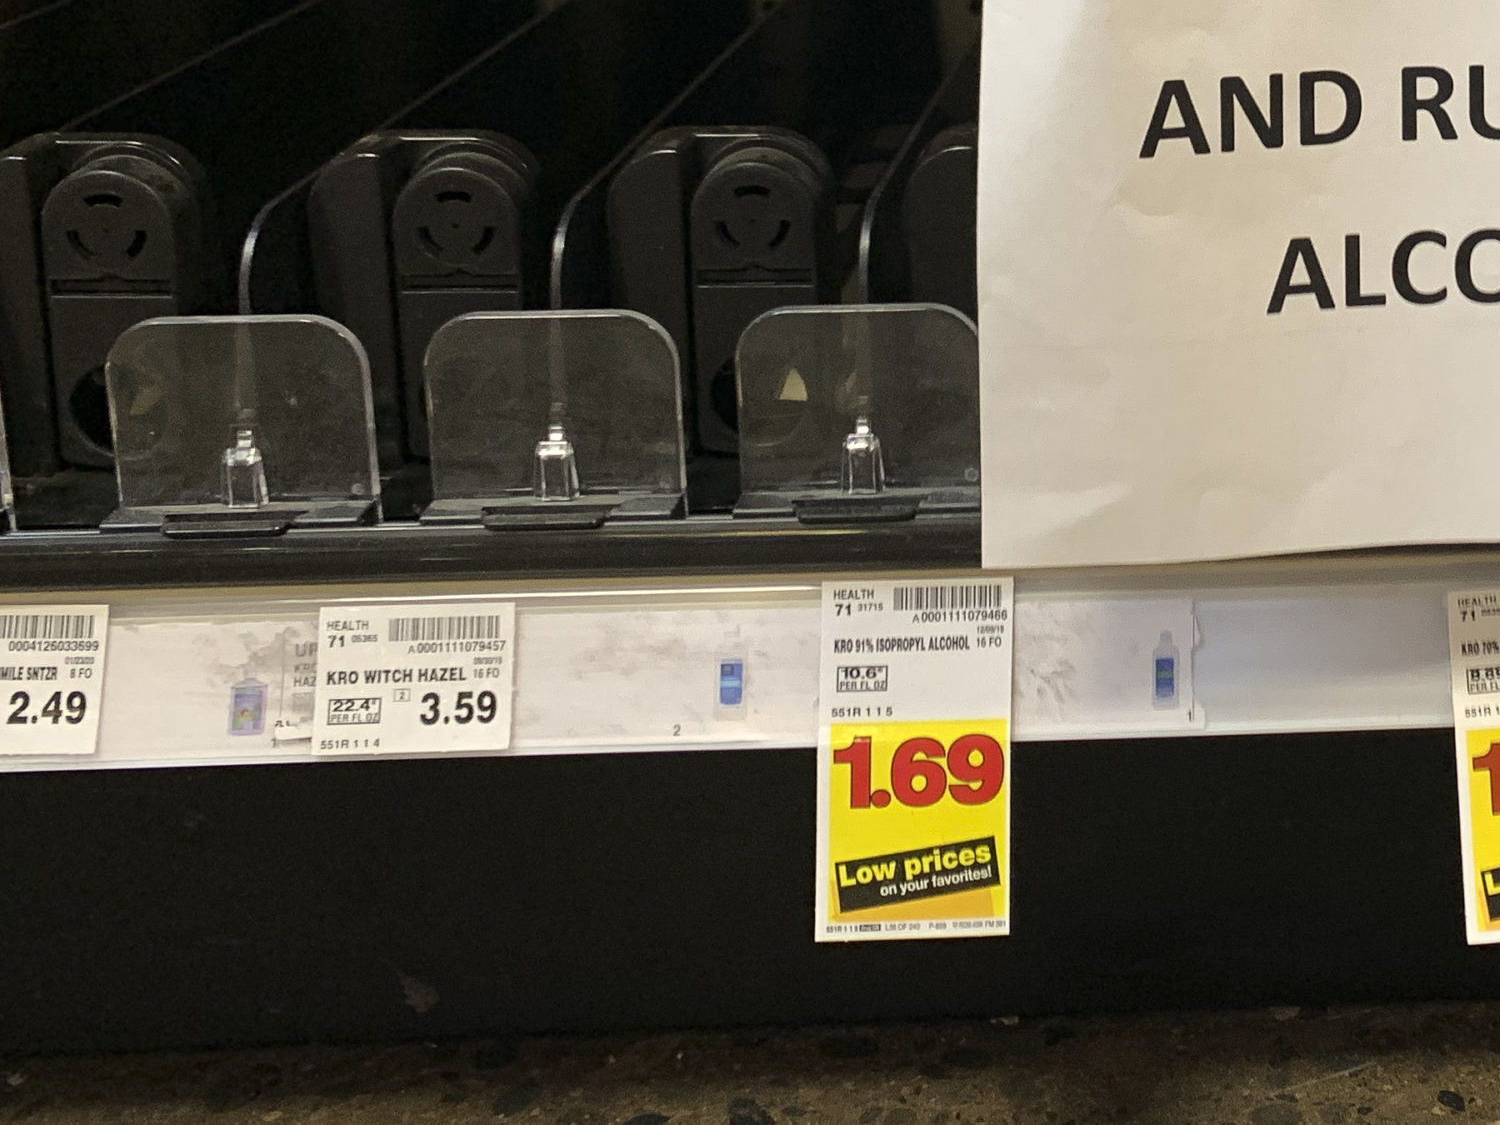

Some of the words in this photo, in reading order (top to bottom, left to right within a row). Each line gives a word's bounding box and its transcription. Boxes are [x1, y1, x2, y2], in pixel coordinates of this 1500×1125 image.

[1139, 70, 1363, 159] AND
[834, 589, 874, 600] HEALTH
[1458, 596, 1497, 608] HEALTH
[835, 604, 851, 616] 71
[1460, 611, 1476, 622] 71
[327, 620, 369, 631] HEALTH
[328, 636, 345, 648] 71
[834, 639, 852, 653] KRO
[856, 639, 874, 653] 91%
[876, 637, 925, 652] ISOPROPYL
[928, 636, 969, 650] ALCOHOL
[976, 638, 986, 647] 16
[989, 637, 1001, 647] FO
[1462, 643, 1479, 656] KRO
[1483, 642, 1499, 654] 70%
[79, 668, 92, 678] FO
[327, 671, 358, 685] KRO
[364, 669, 413, 684] WITCH
[418, 667, 466, 682] HAZEL
[473, 669, 483, 678] 16
[487, 668, 499, 678] FO
[840, 681, 856, 690] PER
[860, 681, 870, 690] FL
[874, 680, 885, 690] OZ
[7, 691, 87, 724] 2.49
[420, 691, 497, 725] 3.59
[832, 708, 861, 717] 551R
[330, 713, 348, 723] PER
[352, 713, 361, 722] FL
[673, 725, 681, 736] 2
[320, 740, 349, 749] 551R
[373, 739, 380, 747] 4
[834, 734, 1004, 809] 1.69
[838, 861, 896, 887] Low
[904, 845, 992, 880] prices
[880, 885, 897, 897] on
[899, 878, 929, 895] your
[932, 866, 992, 888] favorites!
